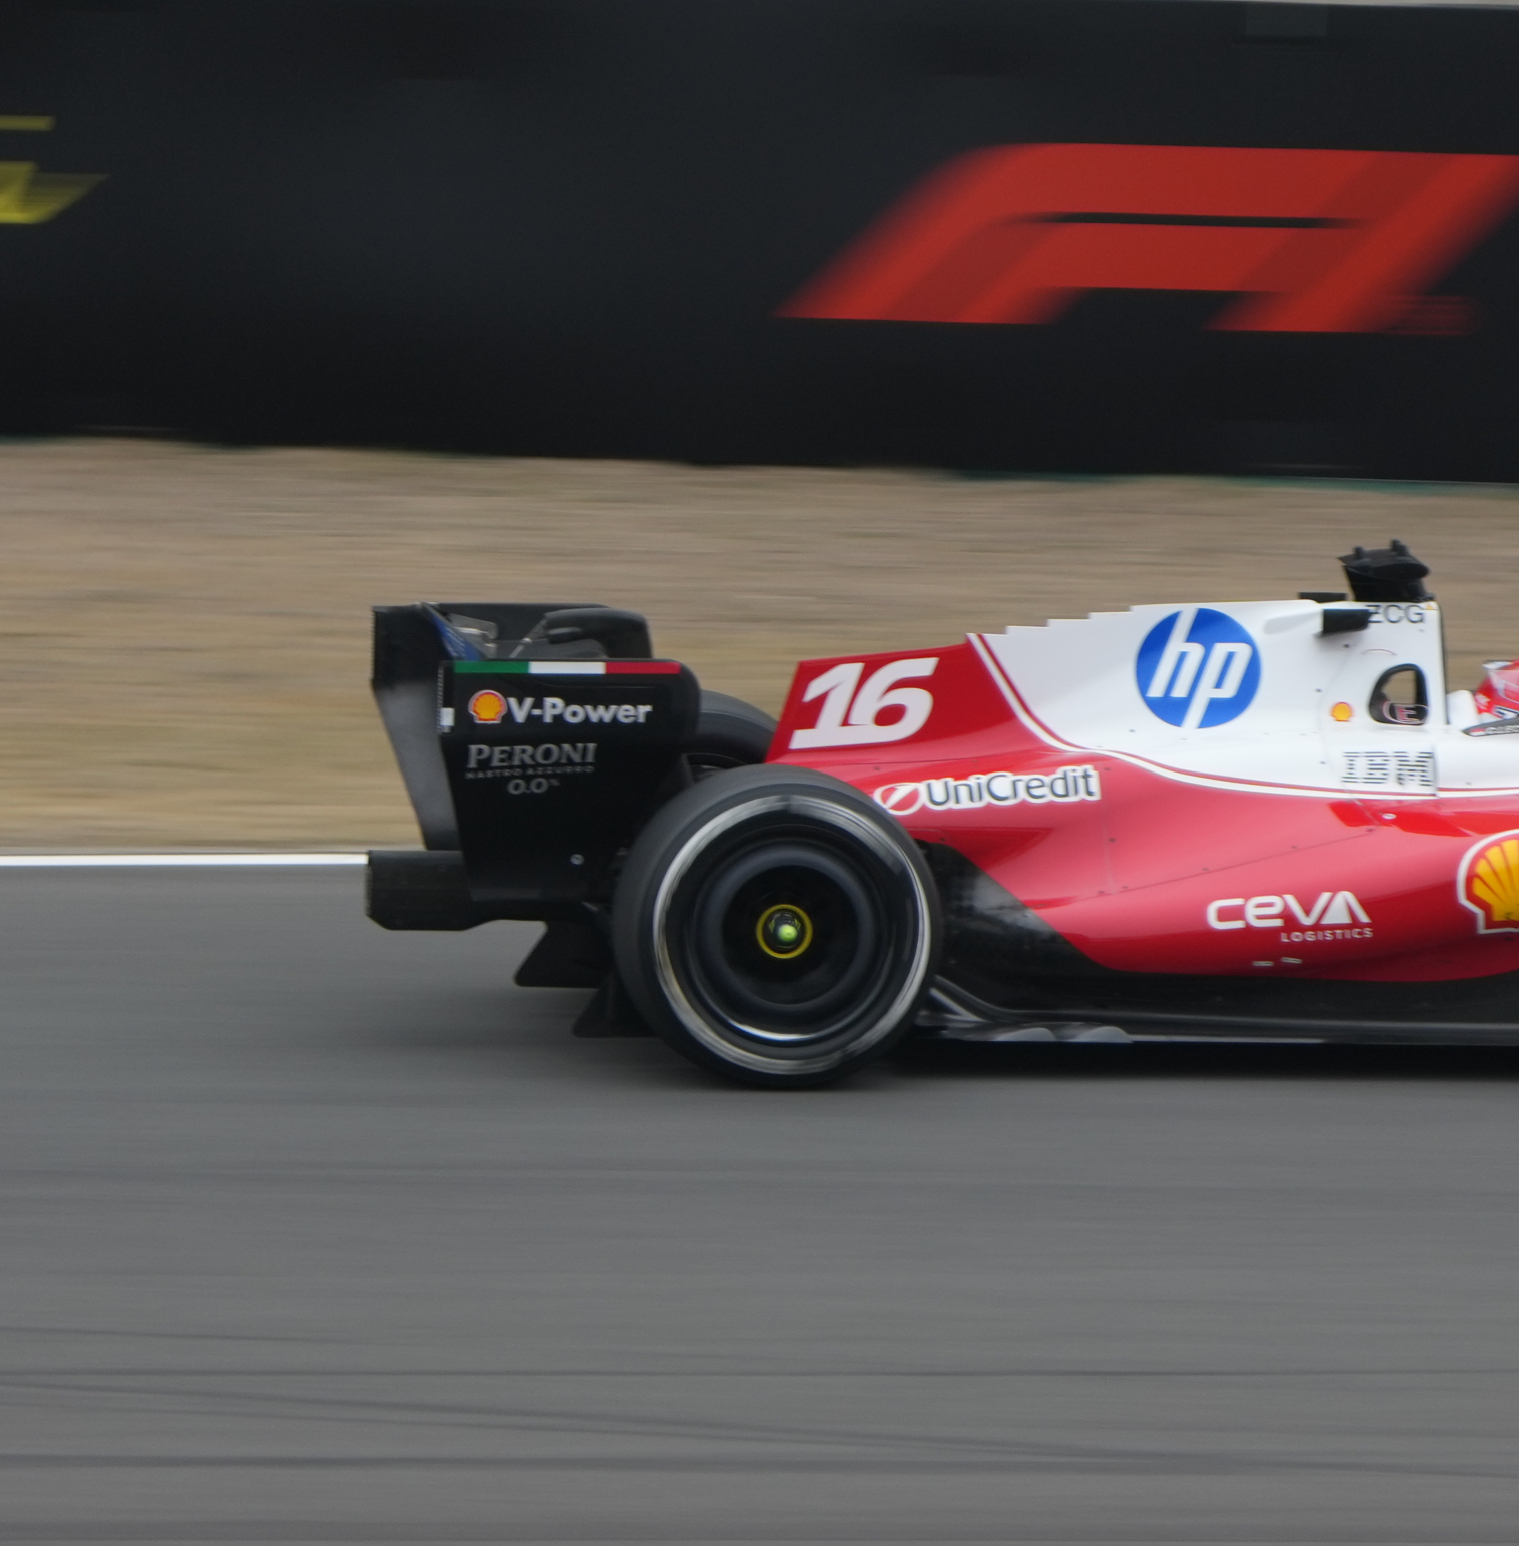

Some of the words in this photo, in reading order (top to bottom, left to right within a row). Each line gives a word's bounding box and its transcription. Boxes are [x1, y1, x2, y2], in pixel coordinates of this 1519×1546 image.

[1145, 607, 1253, 728] hp
[506, 697, 653, 724] V-Power
[789, 657, 940, 749] 16
[466, 743, 598, 769] PERONI
[1341, 751, 1434, 786] IBM
[925, 766, 1099, 808] UniCredit
[1281, 928, 1373, 942] LOGISTICS
